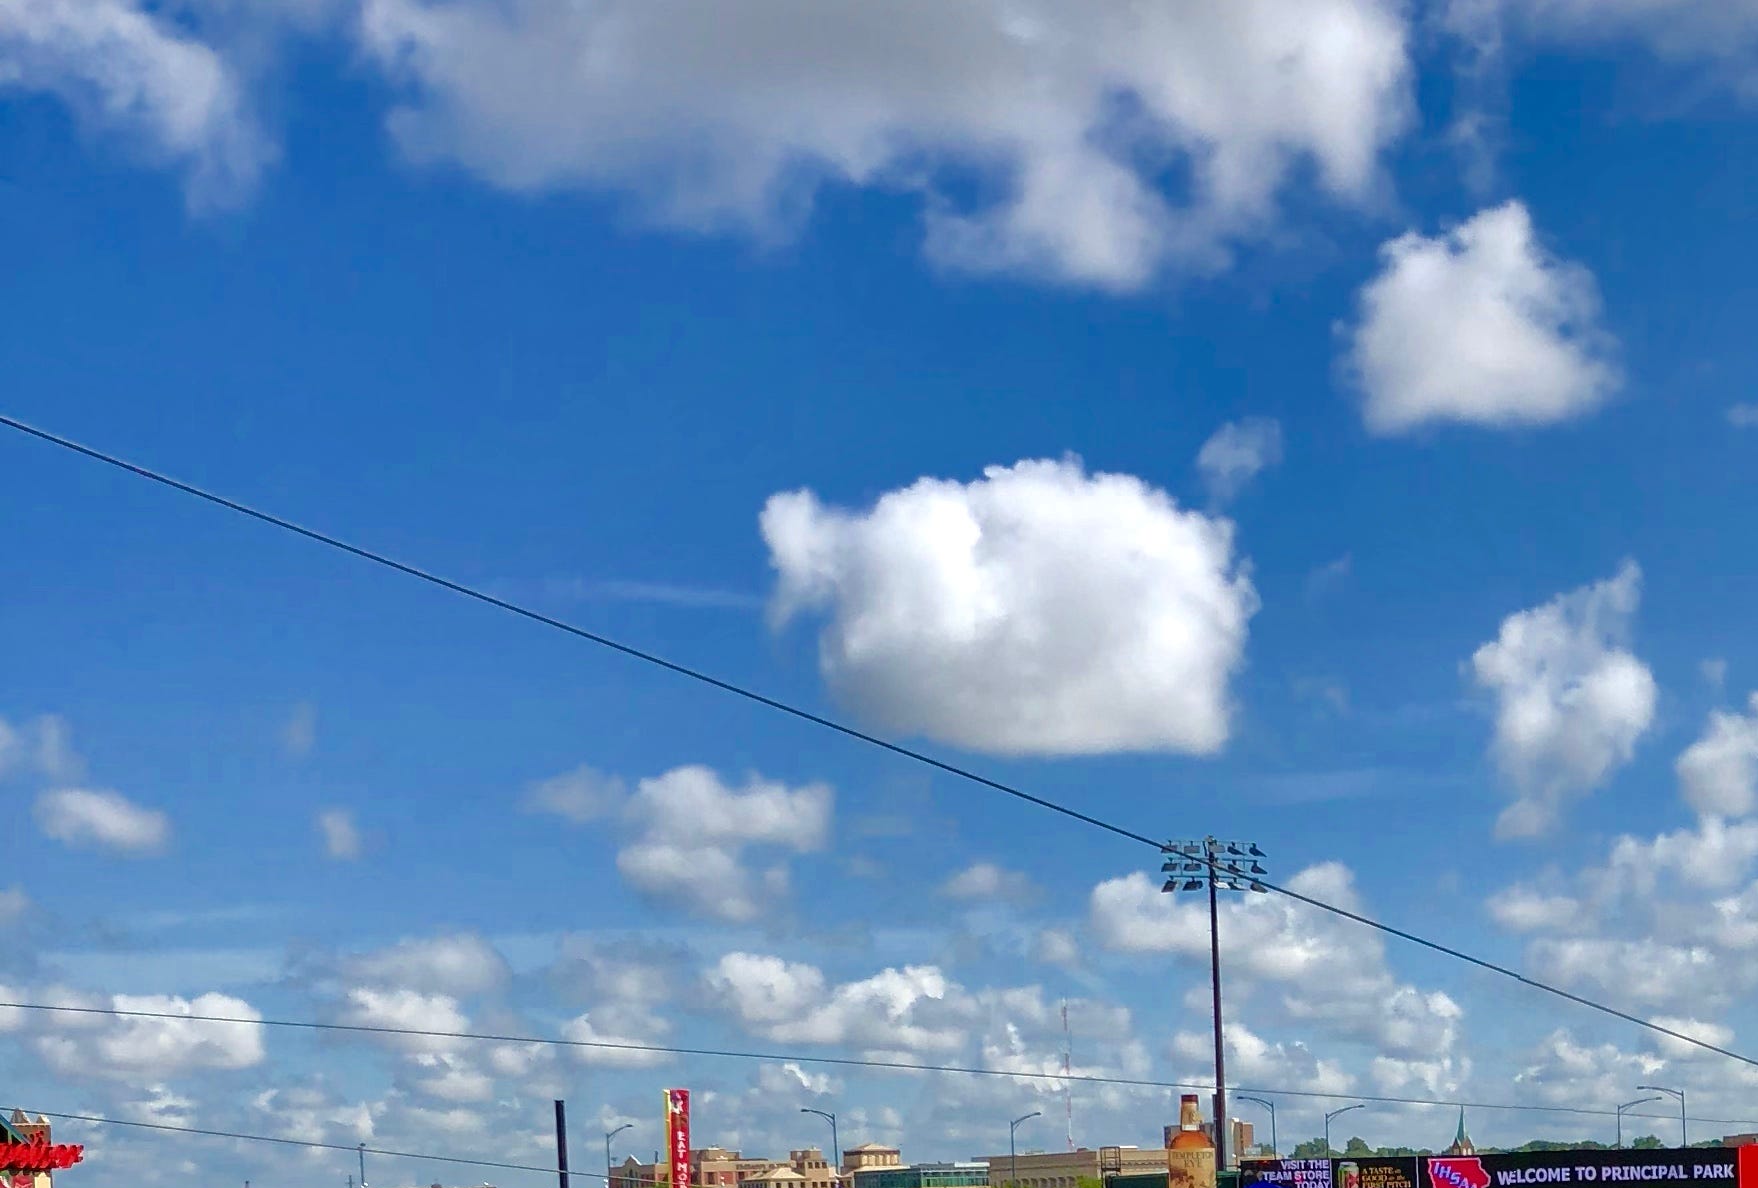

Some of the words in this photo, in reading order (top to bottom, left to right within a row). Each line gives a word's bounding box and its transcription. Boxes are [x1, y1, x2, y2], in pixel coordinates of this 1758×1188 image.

[677, 1131, 687, 1158] EAT
[1171, 1151, 1213, 1160] TEMPLETON
[1184, 1160, 1201, 1168] RYE
[1281, 1161, 1305, 1170] VISIT
[1308, 1160, 1329, 1170] THE
[1263, 1172, 1293, 1181] TEAM
[1295, 1170, 1330, 1181] STORE
[1497, 1169, 1571, 1186] WELCOME
[1575, 1165, 1596, 1182] TO
[1602, 1164, 1688, 1181] PRINCIPAL
[1693, 1163, 1735, 1179] PARK
[1362, 1181, 1385, 1188] FIRST
[1386, 1181, 1411, 1188] PITCH
